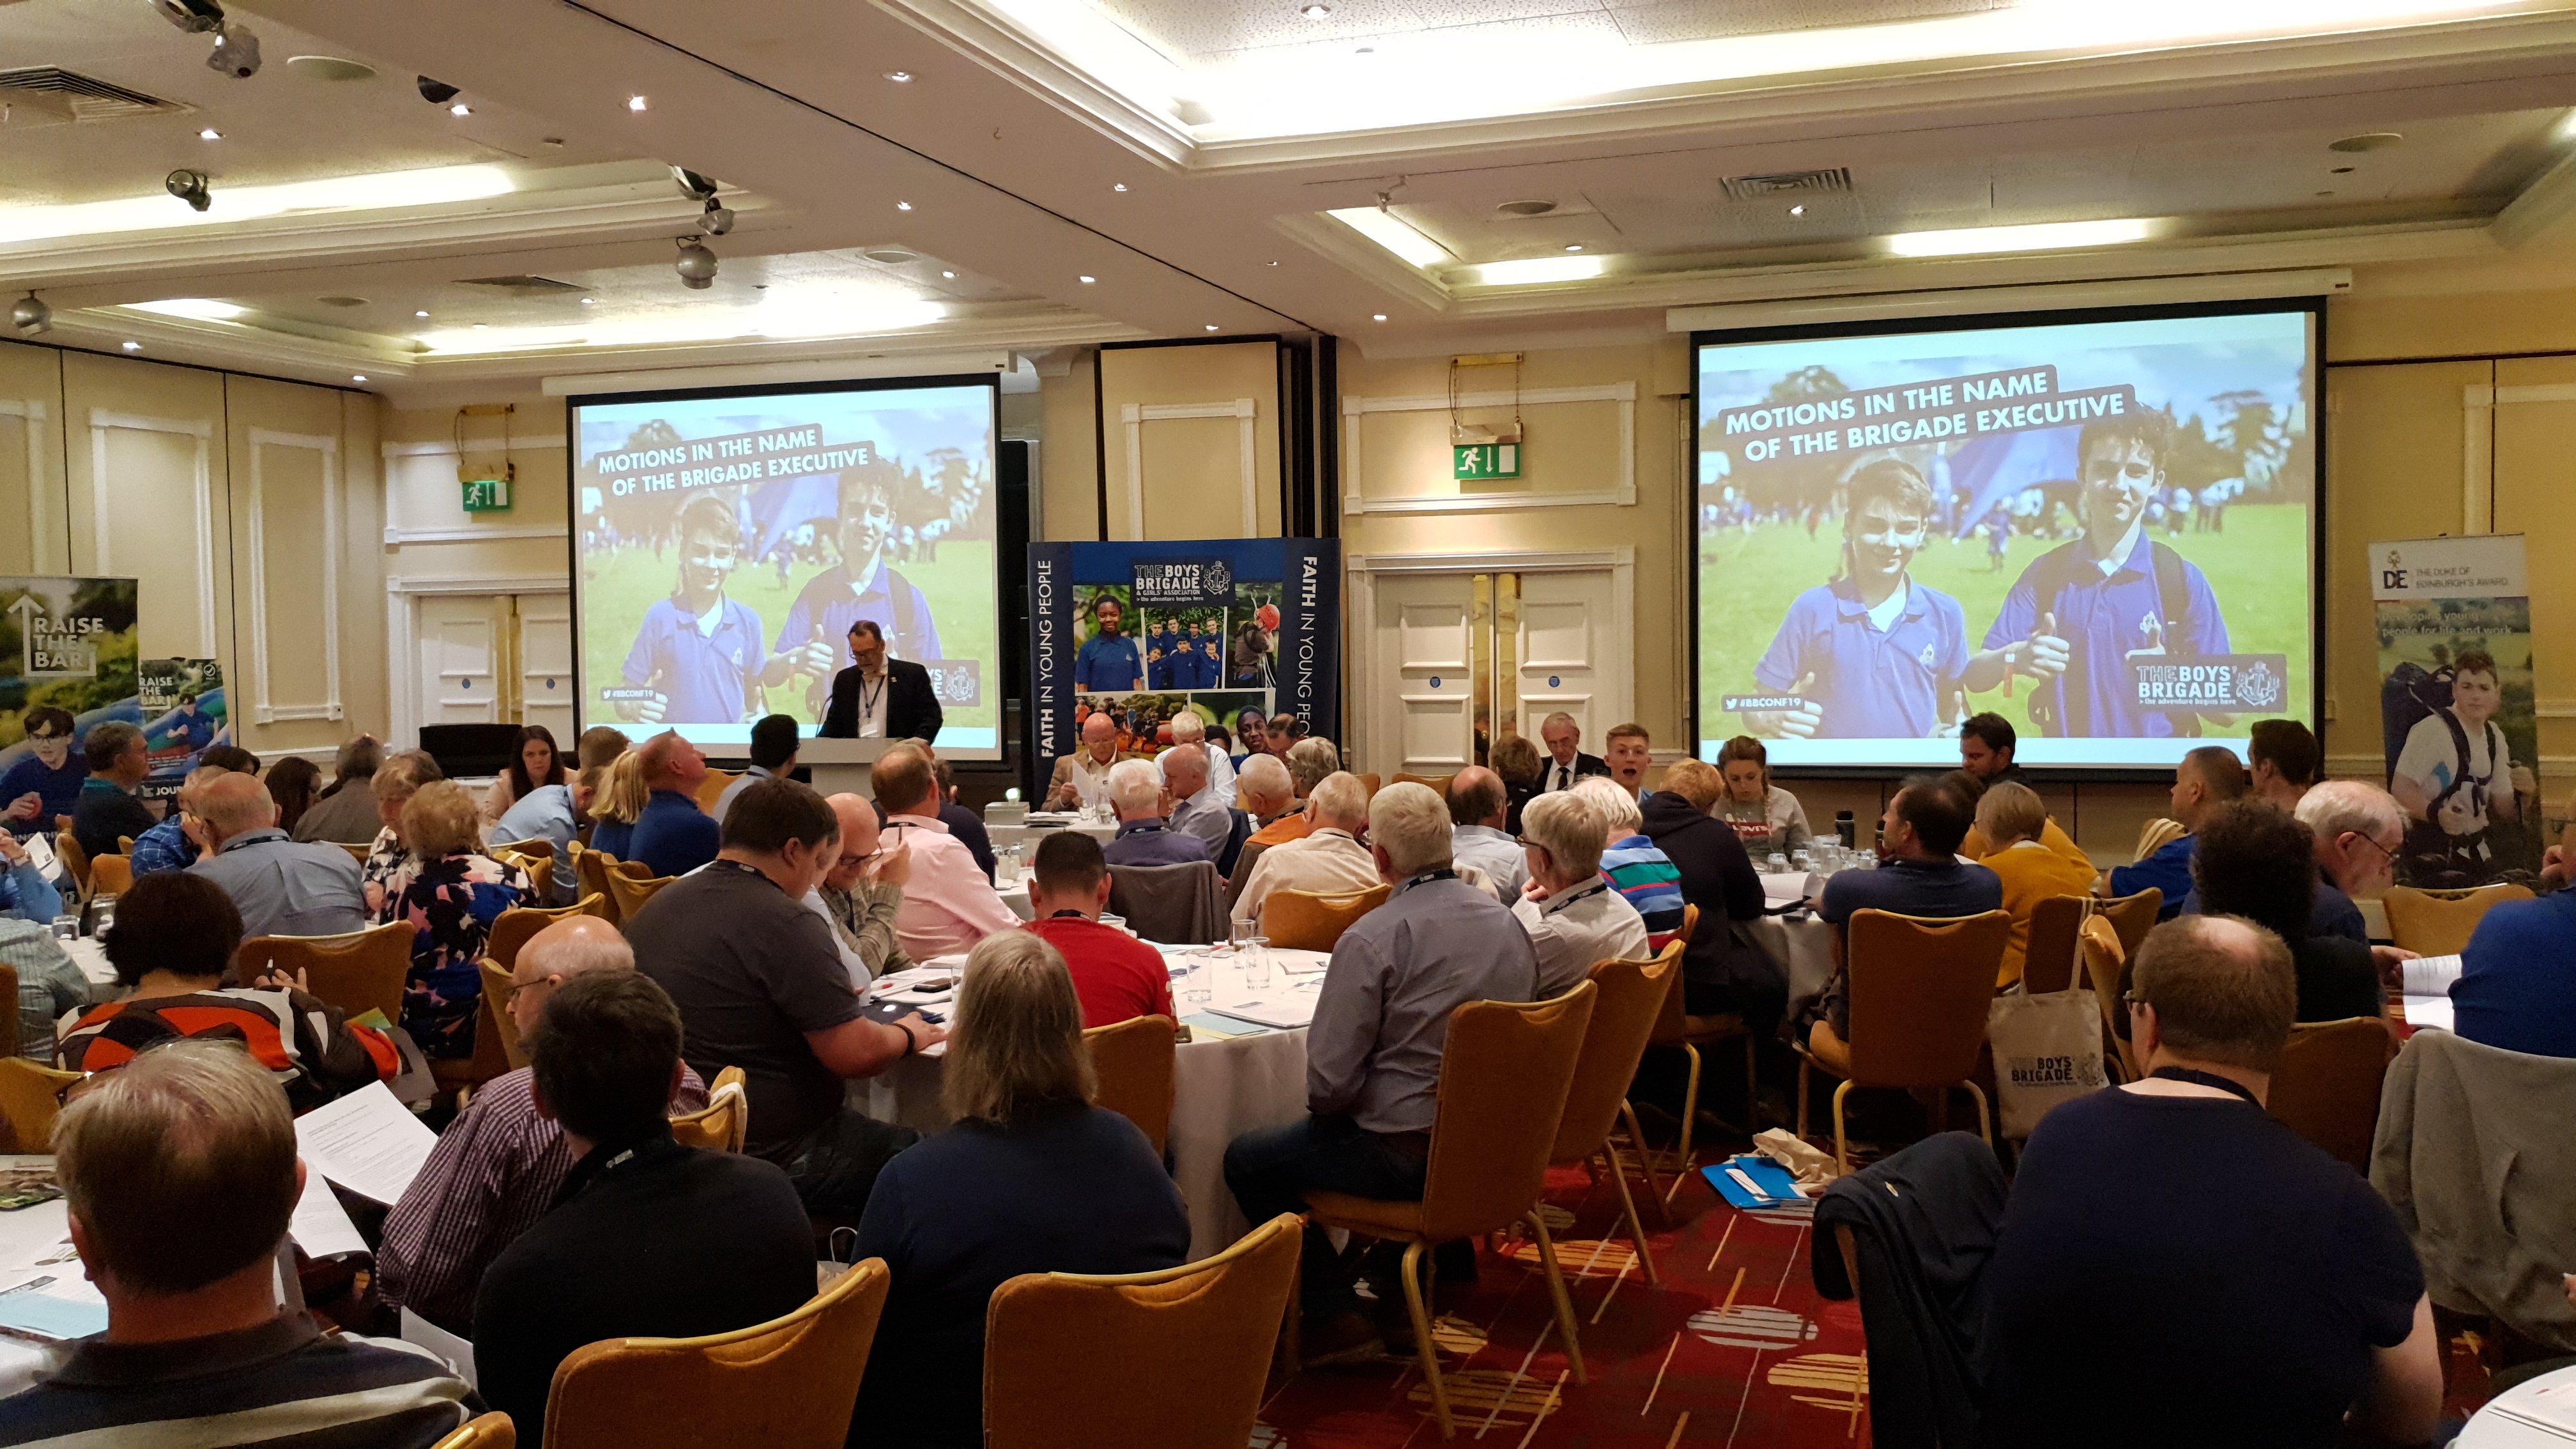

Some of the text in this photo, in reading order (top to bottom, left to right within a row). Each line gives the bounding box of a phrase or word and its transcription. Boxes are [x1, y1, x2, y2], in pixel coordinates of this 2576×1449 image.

[1726, 372, 2048, 435] MOTIONS IN THE NAME
[1745, 393, 2125, 461] OF THE BRIGADE EXECUTIVE
[599, 429, 816, 473] MOTIONS IN THE NAME
[611, 447, 869, 496] OF THE BRIGADE EXECUTIVE
[1135, 564, 1204, 578] THE BOYS'
[2434, 567, 2456, 576] DUKE
[2459, 567, 2471, 575] OF
[1136, 577, 1200, 590] BRIGADE
[1301, 556, 1317, 606] FAITH
[2476, 578, 2509, 586] AWARD
[34, 617, 103, 633] RAISE
[1300, 613, 1315, 631] IN
[2382, 612, 2479, 623] Developing young
[2382, 625, 2512, 638] people for life and work
[33, 634, 77, 650] THE
[34, 652, 84, 668] BAR
[1038, 560, 1054, 758] FAITH IN YOUNG PEOPLE
[1298, 635, 1314, 698] YOUNG
[139, 677, 173, 686] RAISE
[2136, 666, 2177, 682] THE
[140, 687, 160, 696] THE
[2138, 682, 2230, 698] BRIGADE
[1739, 698, 1801, 707] #BBCONF19
[2012, 1068, 2073, 1081] BRIGADE
